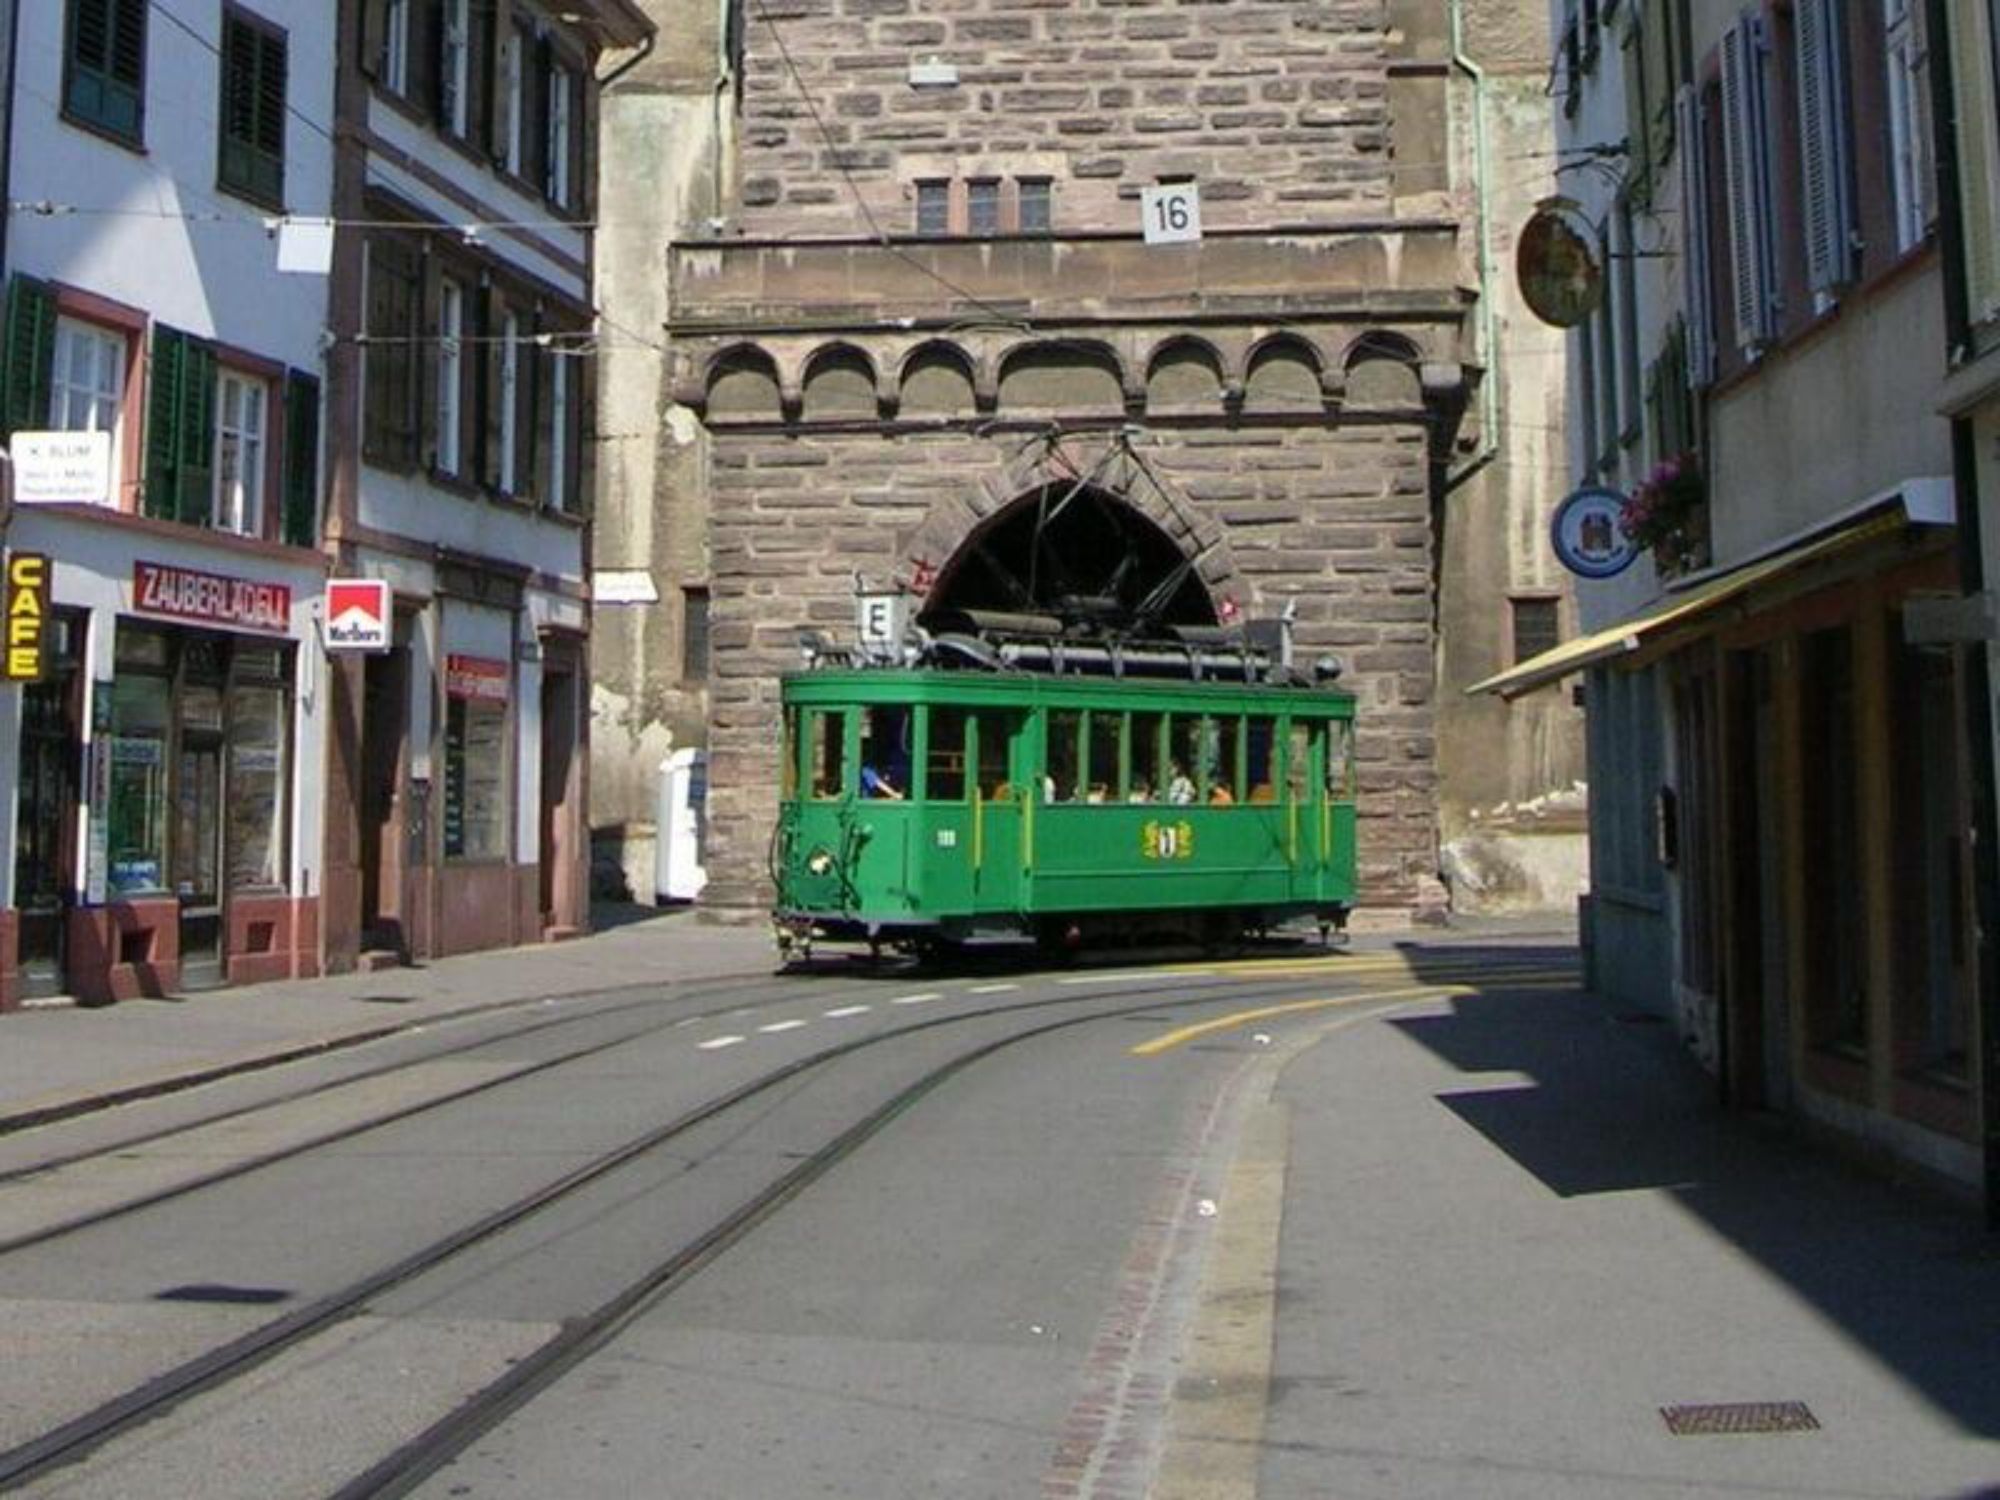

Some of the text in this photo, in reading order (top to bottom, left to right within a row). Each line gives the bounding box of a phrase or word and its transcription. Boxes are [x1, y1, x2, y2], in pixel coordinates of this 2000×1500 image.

[1154, 195, 1189, 231] 16
[9, 557, 43, 677] CAFE
[870, 603, 886, 635] E
